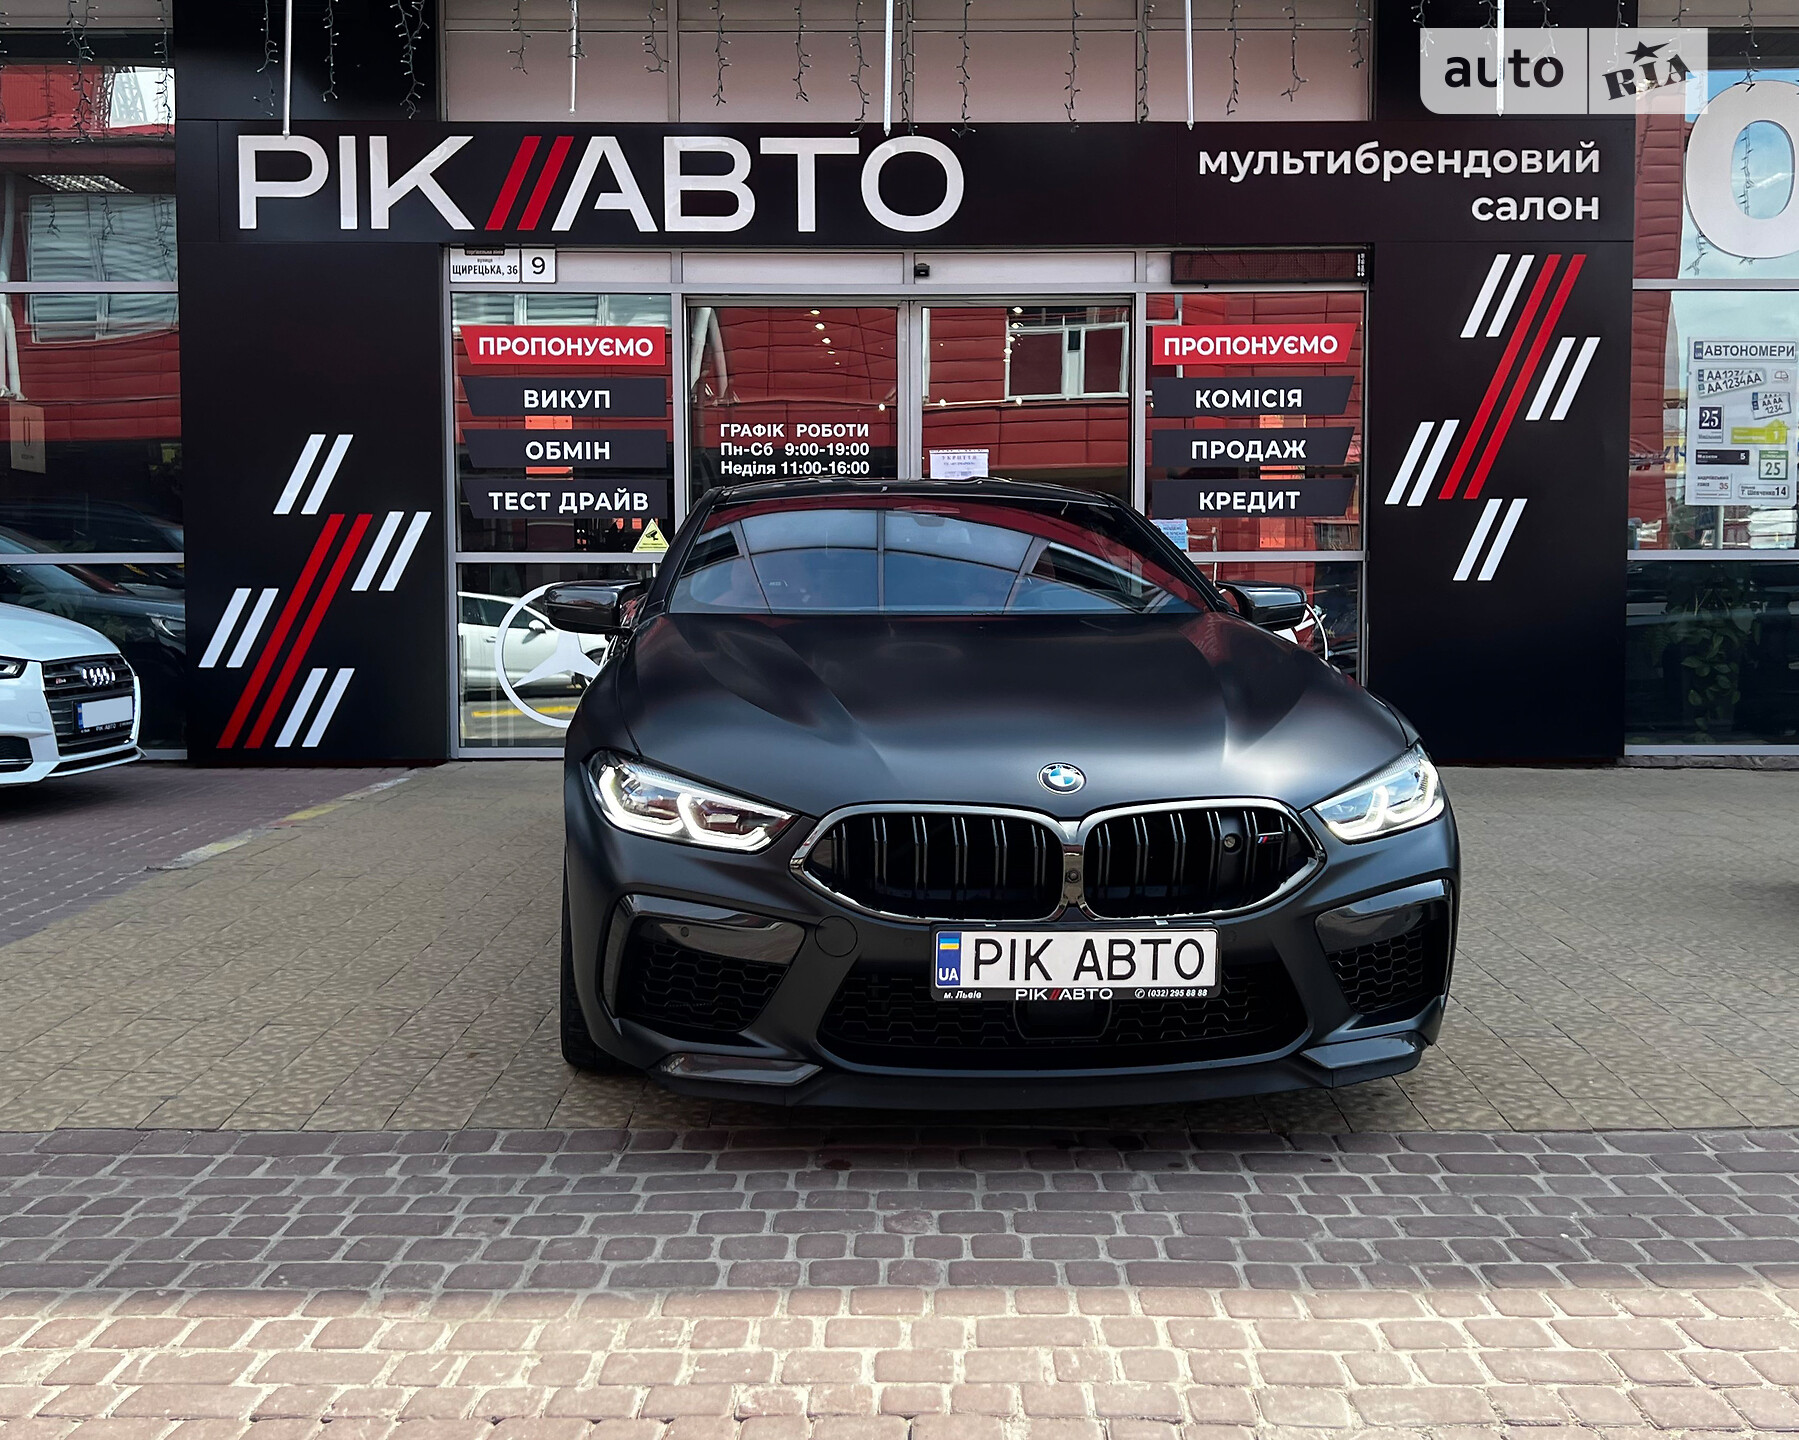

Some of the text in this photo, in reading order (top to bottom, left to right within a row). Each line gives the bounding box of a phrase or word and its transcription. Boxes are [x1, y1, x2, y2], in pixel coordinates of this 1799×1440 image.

[1199, 142, 1600, 182] мультибрендовий
[238, 135, 965, 232] РІК АВТО
[1471, 194, 1600, 221] салон
[452, 265, 518, 276] ЩИРЕЦЬКА, 36
[531, 256, 546, 275] 9
[478, 336, 654, 357] ПРОПОНУЄМО
[1163, 335, 1338, 356] ПРОПОНУЄМО
[1704, 345, 1795, 357] АВТОНОМЕРИ
[523, 389, 611, 409] ВИКУП
[1195, 389, 1302, 409] КОМІСІЯ
[1702, 409, 1719, 427] 25
[720, 423, 869, 437] ГРАФІК РОБОТИ
[525, 440, 611, 461] ОБМІН
[720, 442, 870, 456] Пн-Сб 9:00-19:00
[1191, 439, 1307, 460] ПРОДАЖ
[720, 461, 870, 476] Неділя 11:00-16:00
[1765, 462, 1781, 476] 25
[488, 488, 649, 514] ТЕСТ ДРАЙВ
[1775, 486, 1786, 496] 14
[1198, 491, 1300, 513] КРЕДИТ
[973, 938, 1205, 981] РІК АВТО
[939, 967, 959, 982] UA
[1147, 988, 1169, 997] (032)
[1169, 989, 1185, 997] 295
